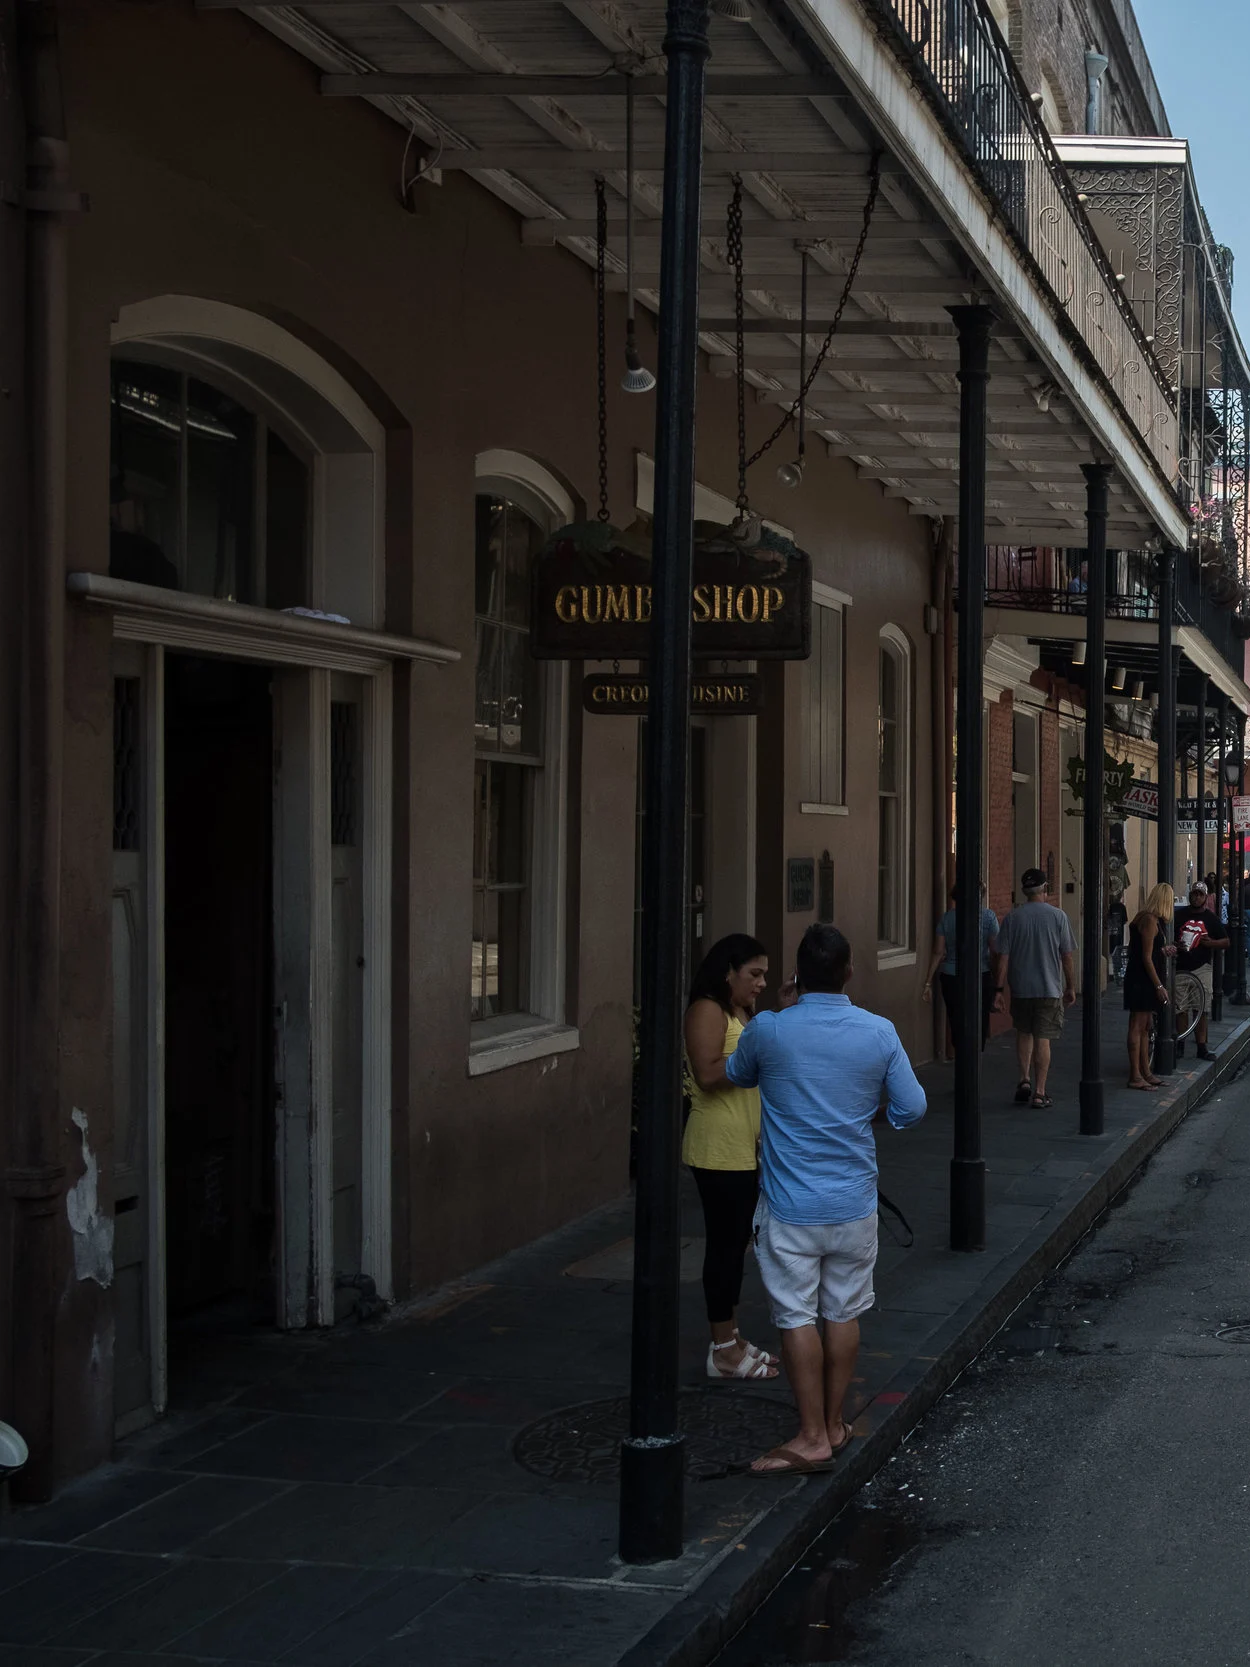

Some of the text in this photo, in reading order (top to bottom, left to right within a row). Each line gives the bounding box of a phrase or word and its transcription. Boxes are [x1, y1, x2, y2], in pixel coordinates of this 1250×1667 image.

[555, 584, 785, 624] GUMB SHOP
[592, 684, 649, 703] CREO
[1178, 821, 1193, 829] NEW
